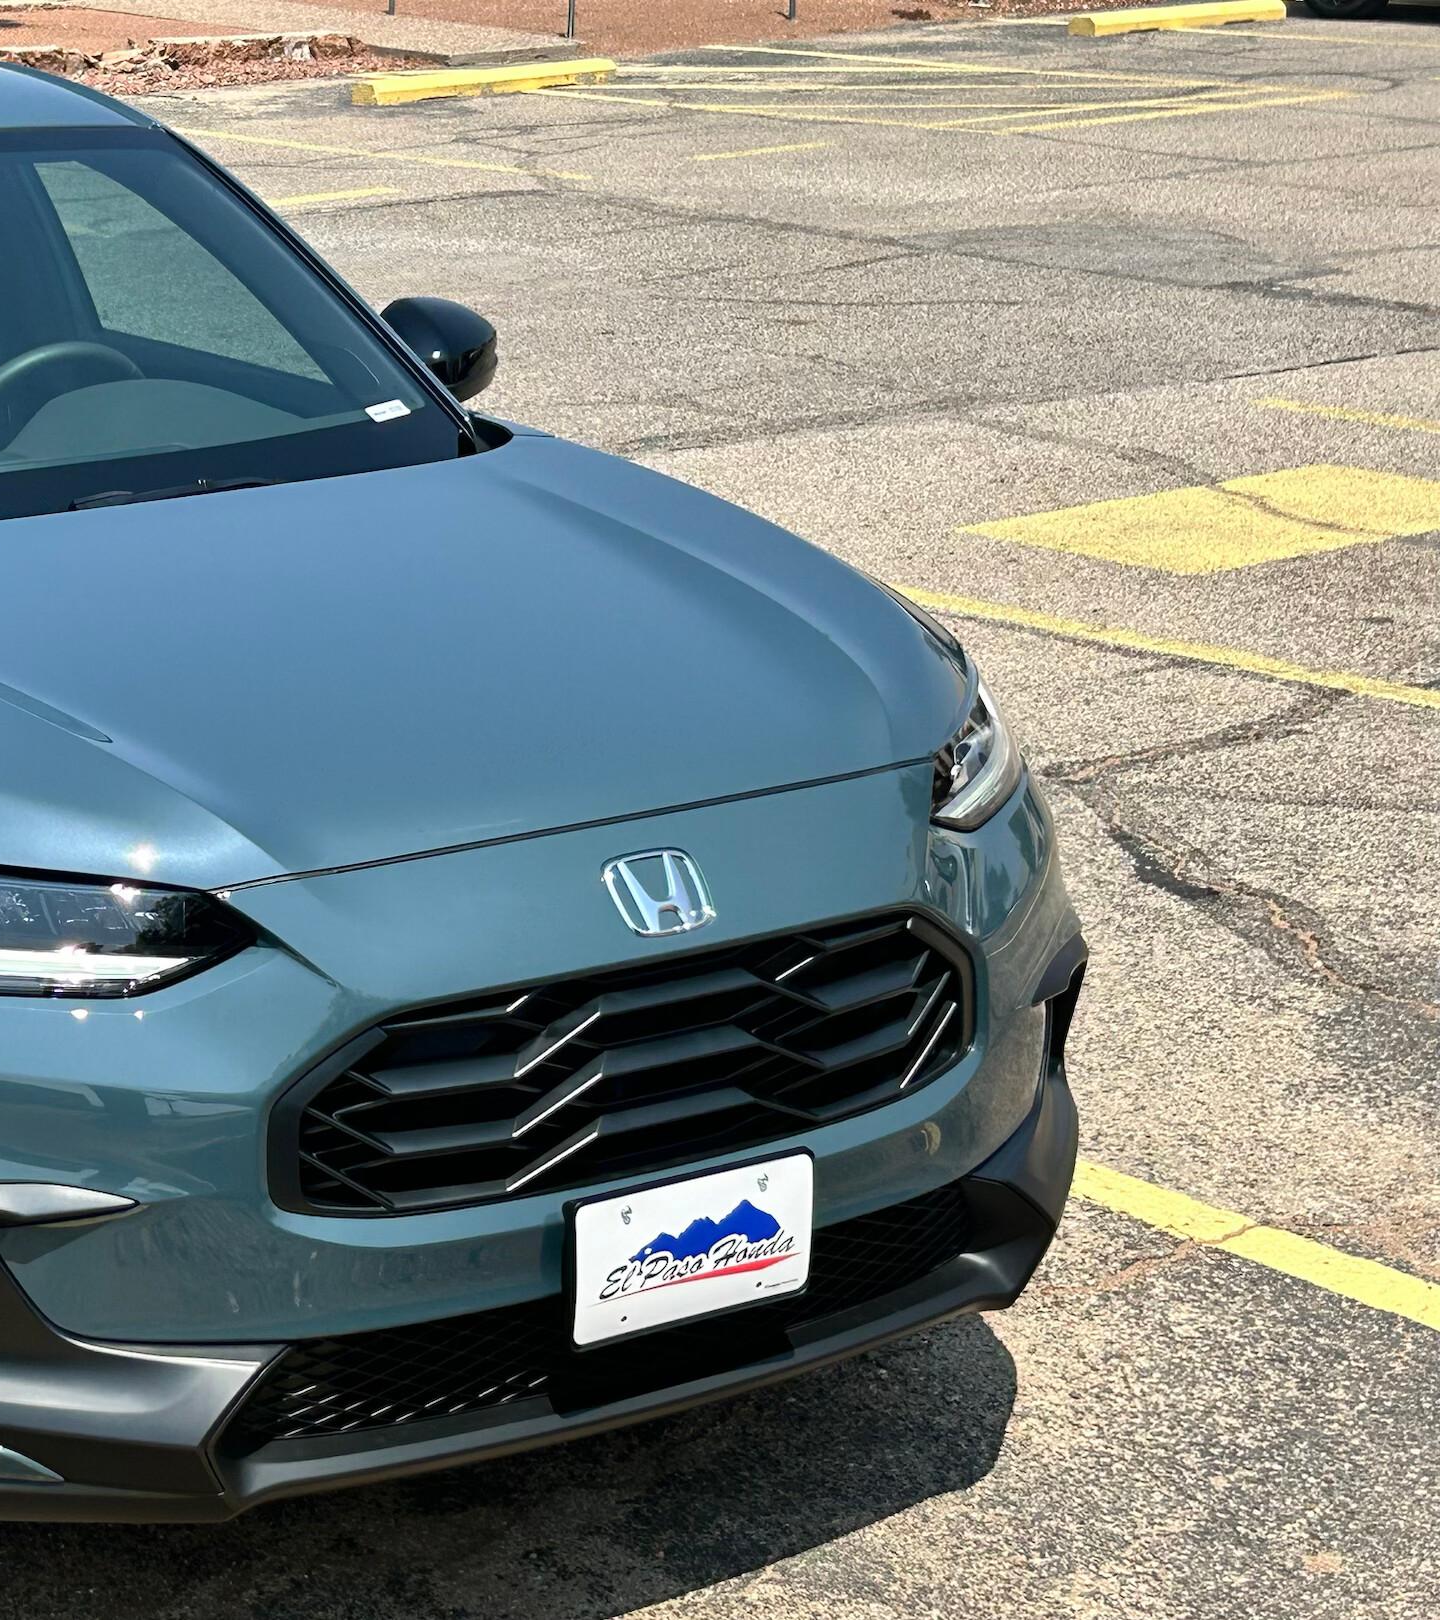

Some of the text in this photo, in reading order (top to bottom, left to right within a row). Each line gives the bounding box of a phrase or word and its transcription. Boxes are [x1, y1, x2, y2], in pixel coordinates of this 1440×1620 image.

[599, 1229, 796, 1300] El Paso Honda
